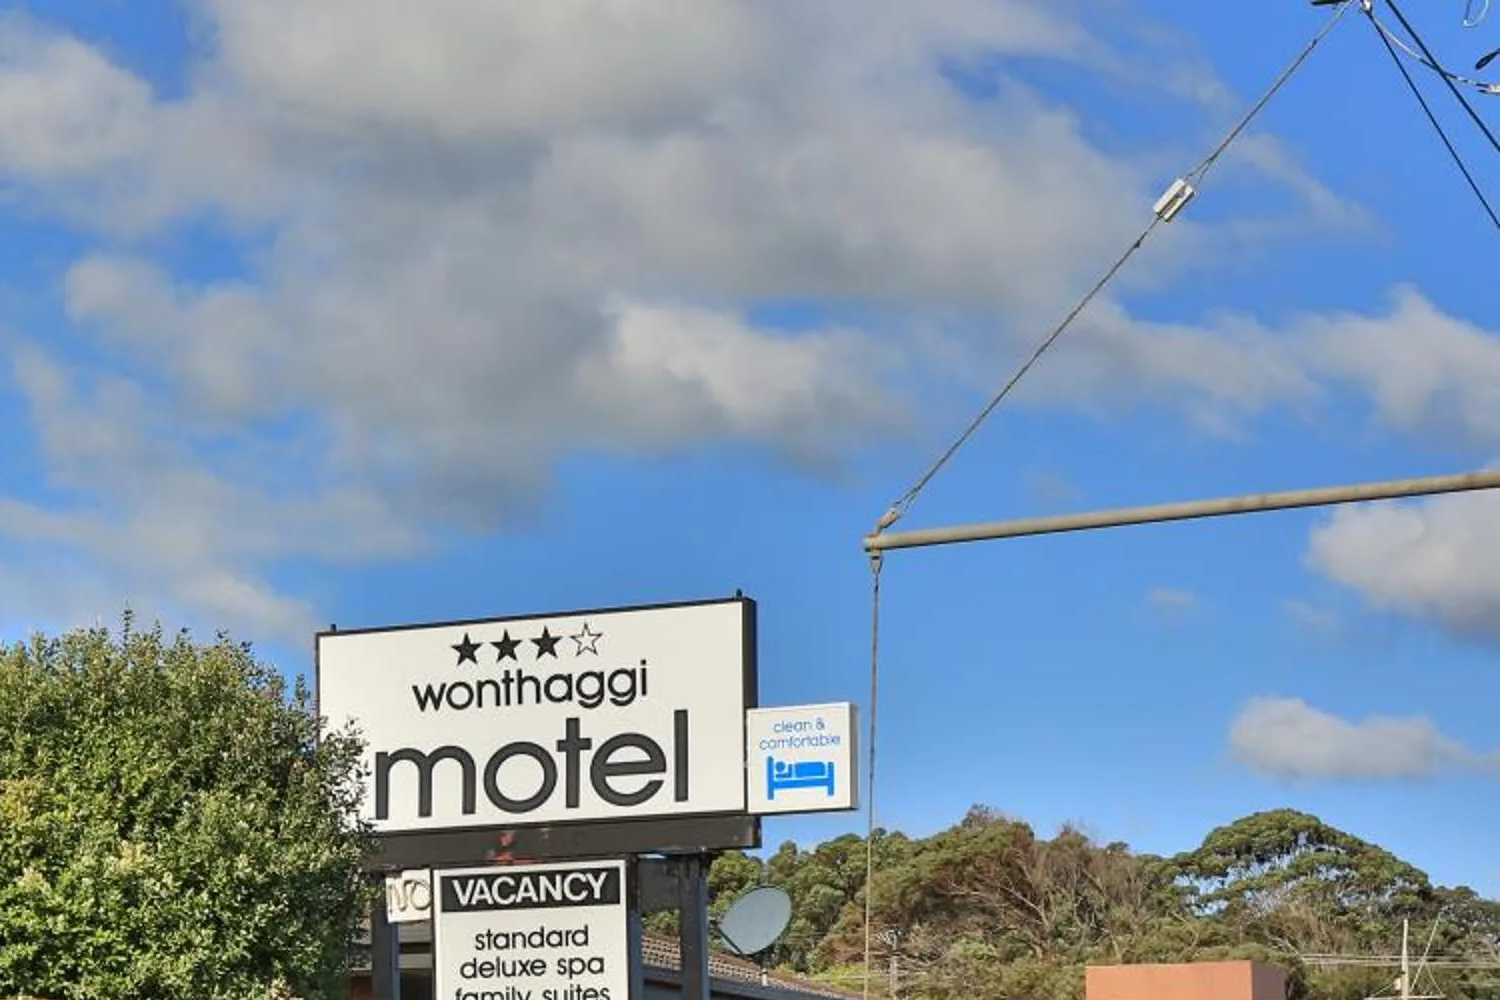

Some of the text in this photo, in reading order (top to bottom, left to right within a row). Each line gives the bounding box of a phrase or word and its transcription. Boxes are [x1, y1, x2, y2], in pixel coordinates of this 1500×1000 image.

[411, 659, 648, 710] wonthaggi
[772, 717, 825, 733] clean &
[758, 734, 842, 751] comfortable
[375, 708, 689, 821] motel
[388, 879, 431, 912] NO
[451, 871, 608, 907] VACANCY
[474, 924, 589, 951] standard
[460, 955, 605, 979] deluxe spa
